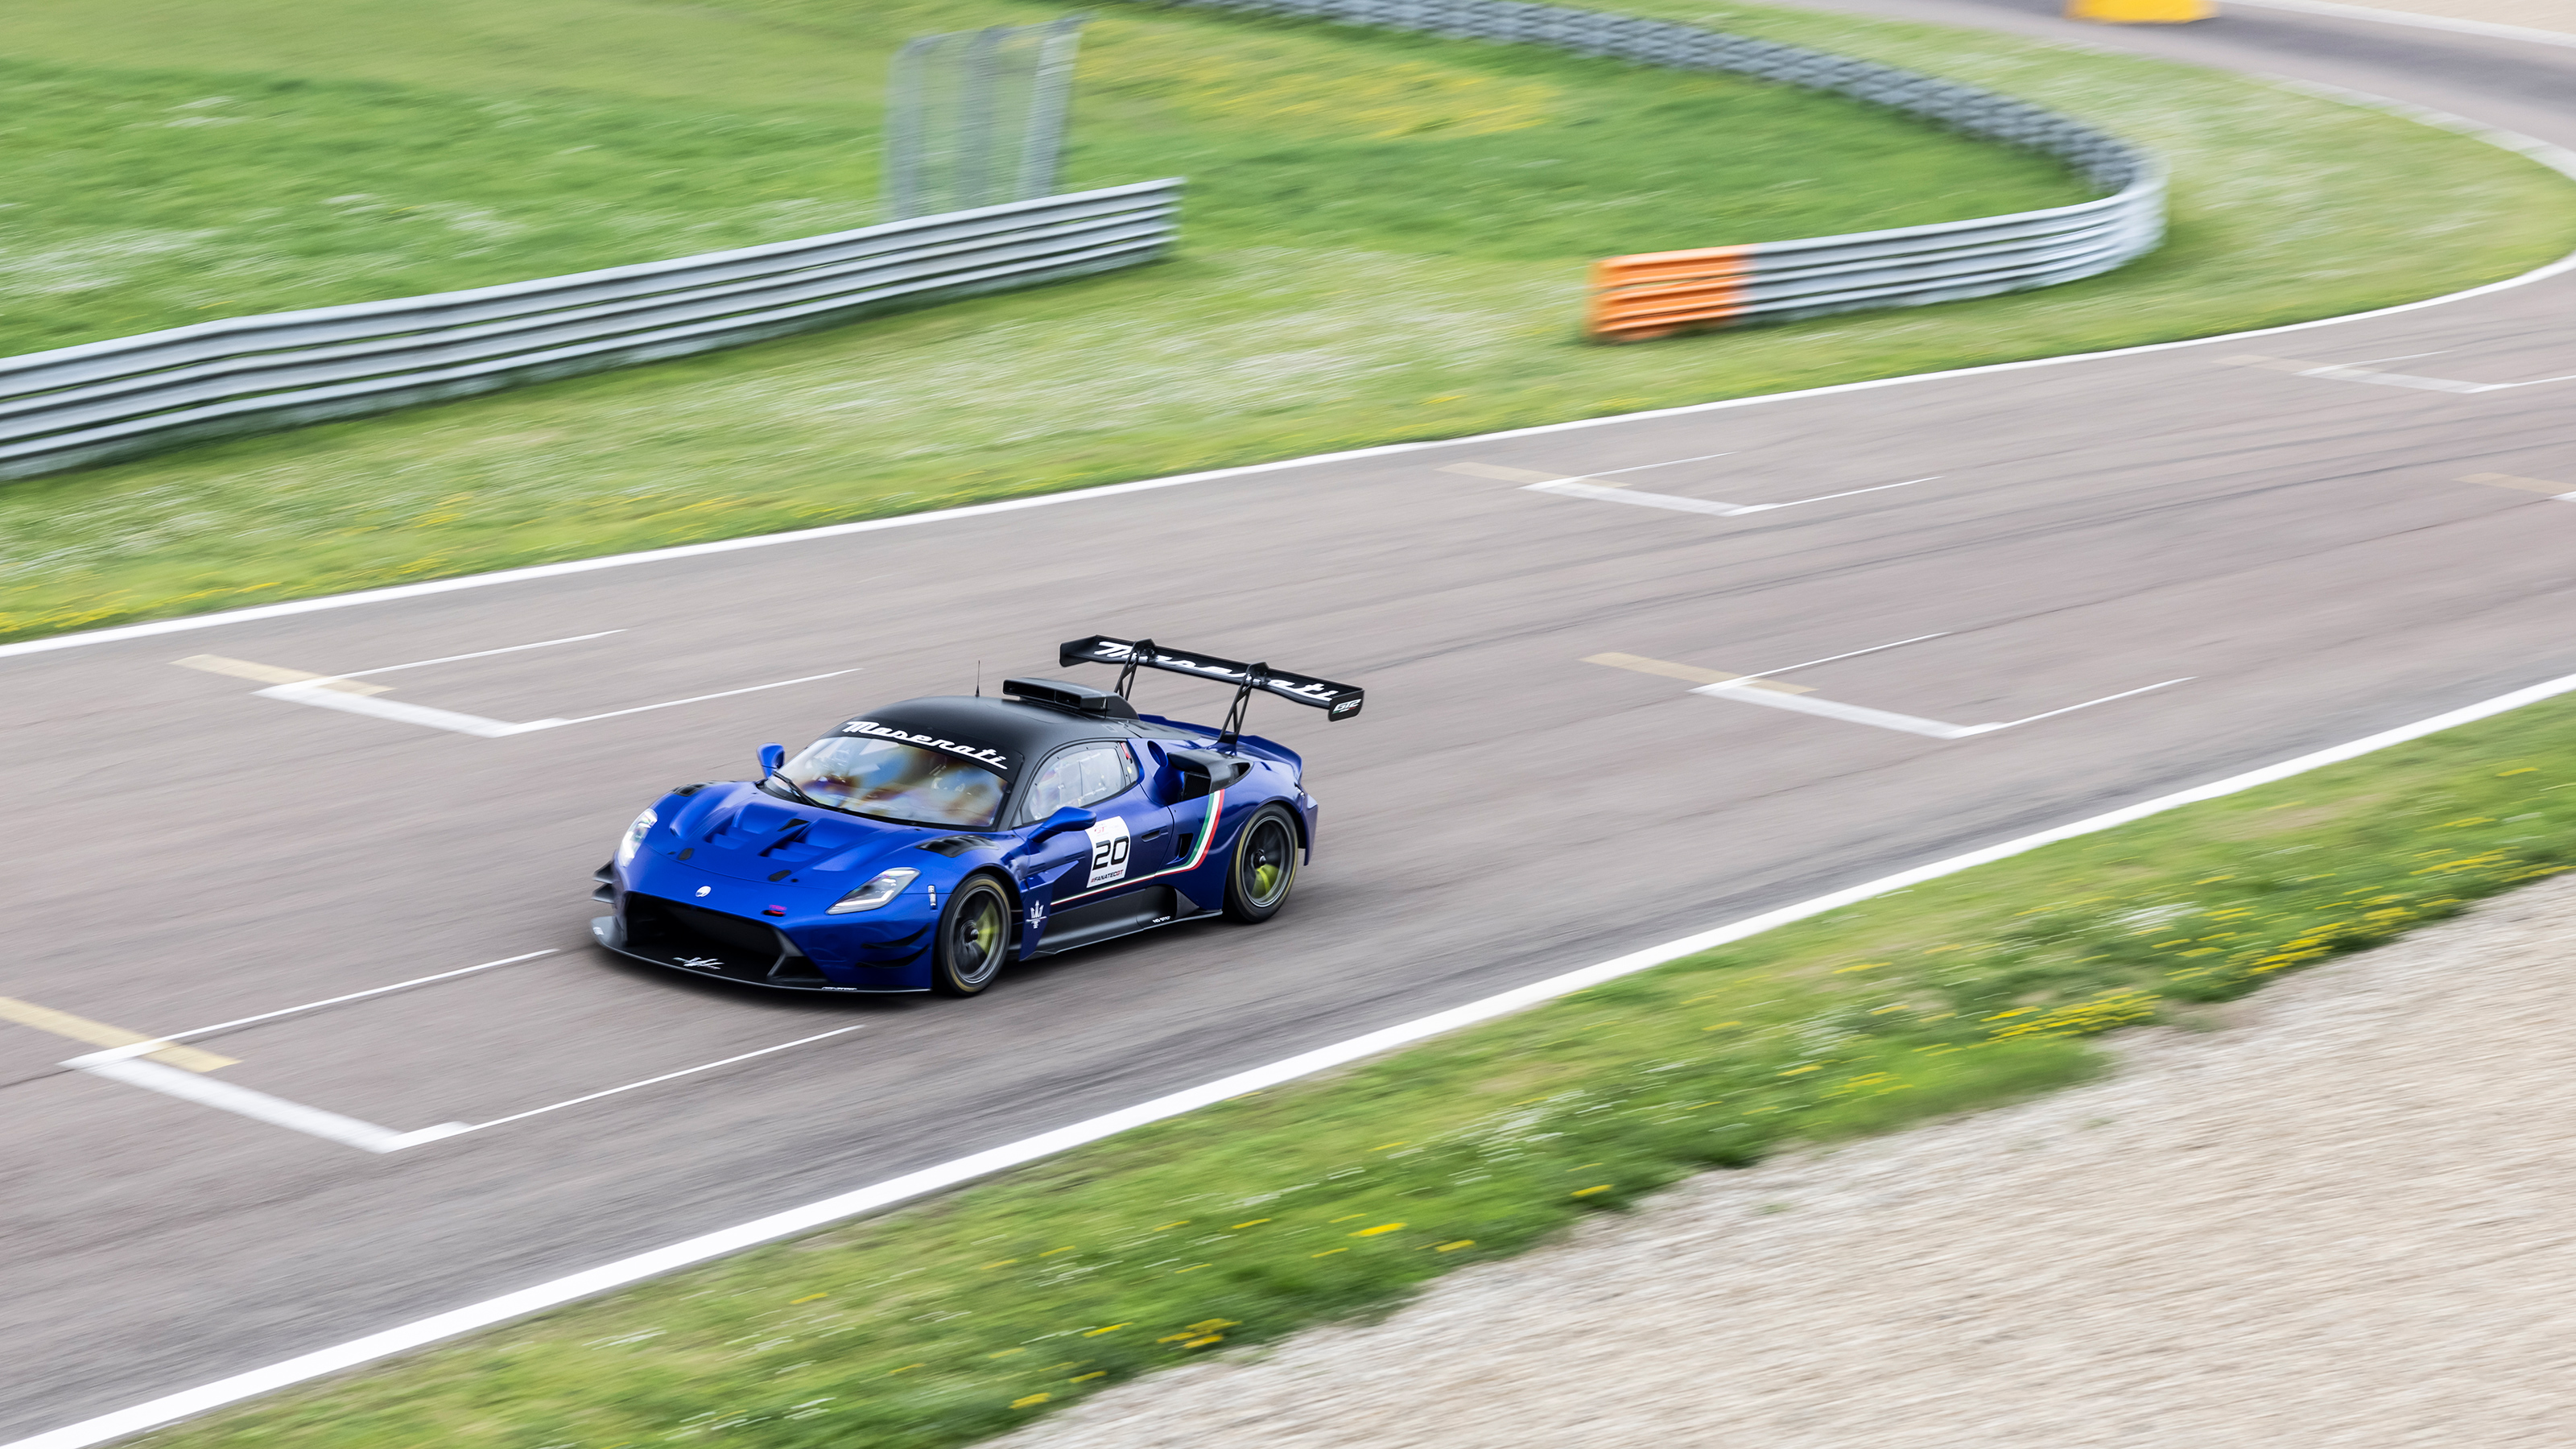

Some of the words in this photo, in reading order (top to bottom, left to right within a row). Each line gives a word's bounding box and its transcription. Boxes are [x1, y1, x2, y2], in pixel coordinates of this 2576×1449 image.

[1333, 699, 1361, 712] GT2
[842, 721, 1008, 770] Maserati
[1092, 836, 1129, 870] 20
[1091, 869, 1124, 882] #FANATECGT
